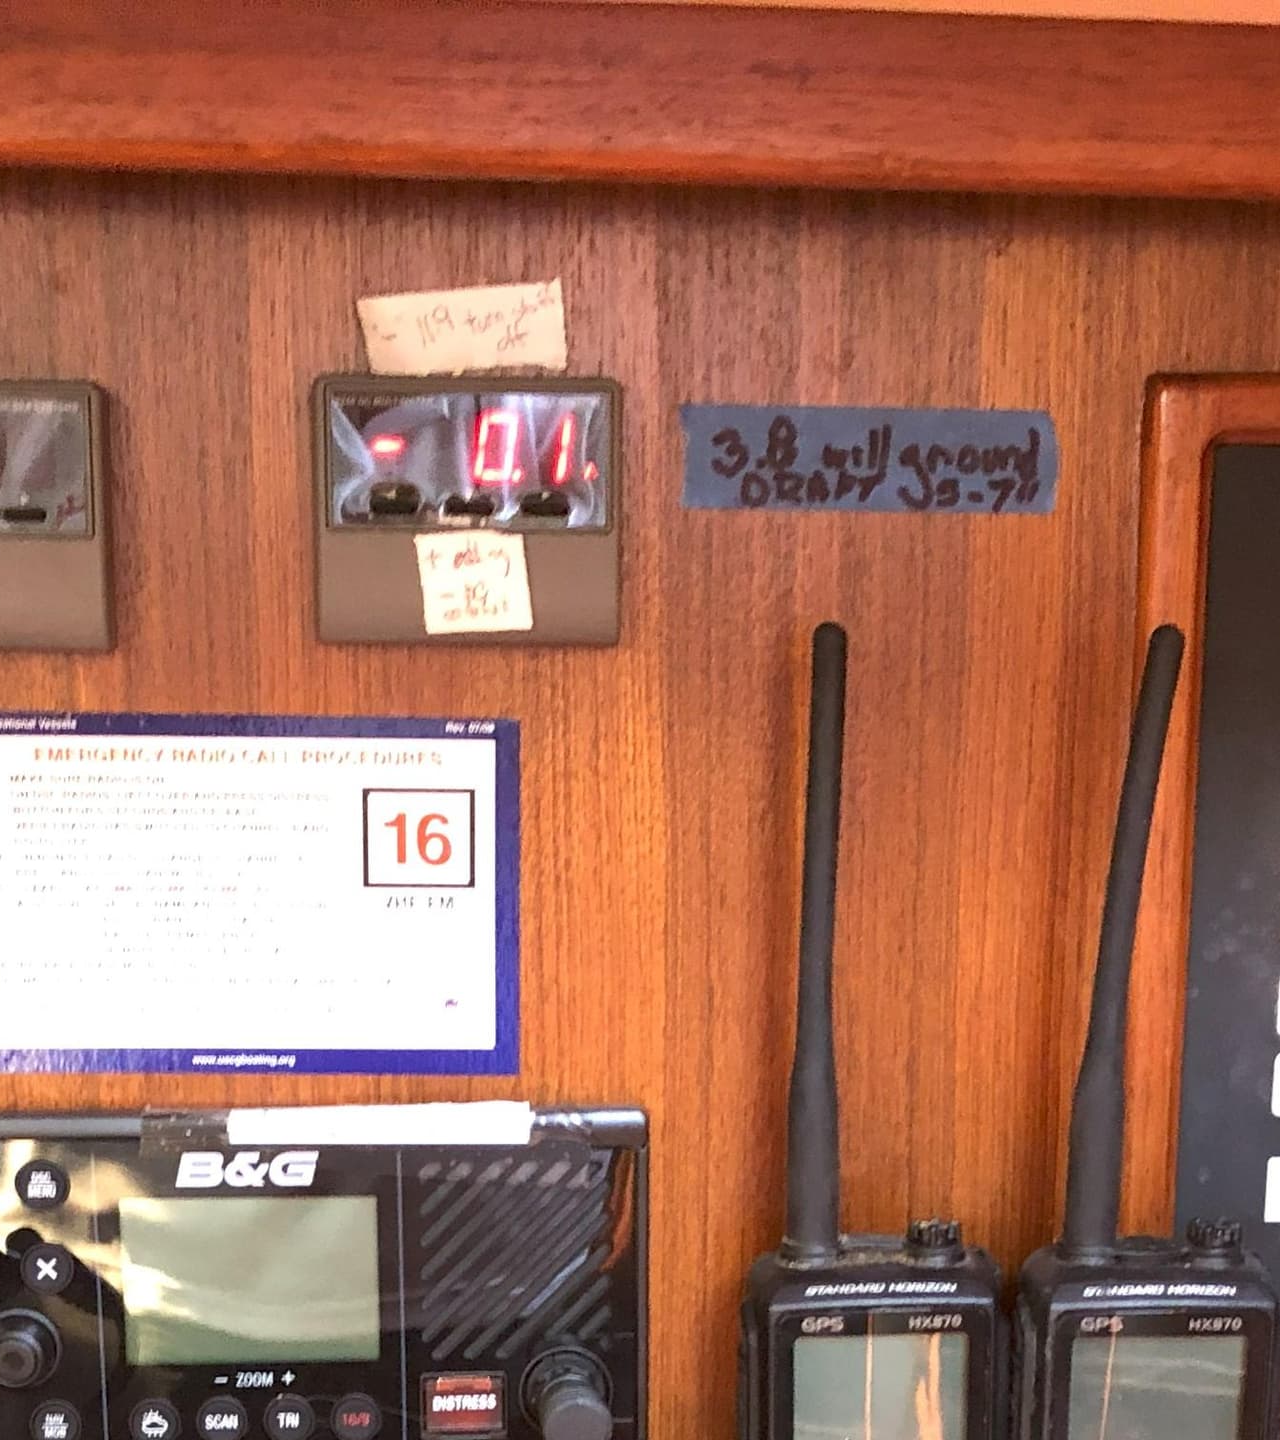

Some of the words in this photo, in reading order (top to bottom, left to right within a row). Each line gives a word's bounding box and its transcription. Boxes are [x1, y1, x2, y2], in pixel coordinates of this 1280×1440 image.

[383, 812, 453, 866] 16
[175, 1150, 318, 1188] B&G
[804, 1282, 886, 1297] STANDARD
[888, 1281, 958, 1294] HORIZON
[1167, 1283, 1238, 1297] HORIZON
[801, 1315, 845, 1333] GPS
[907, 1313, 963, 1331] HX870
[1079, 1315, 1124, 1332] GPS
[1188, 1316, 1243, 1332] HX870
[235, 1371, 275, 1388] ZOOM
[431, 1393, 497, 1412] DISTRESS
[205, 1412, 239, 1430] SCAN
